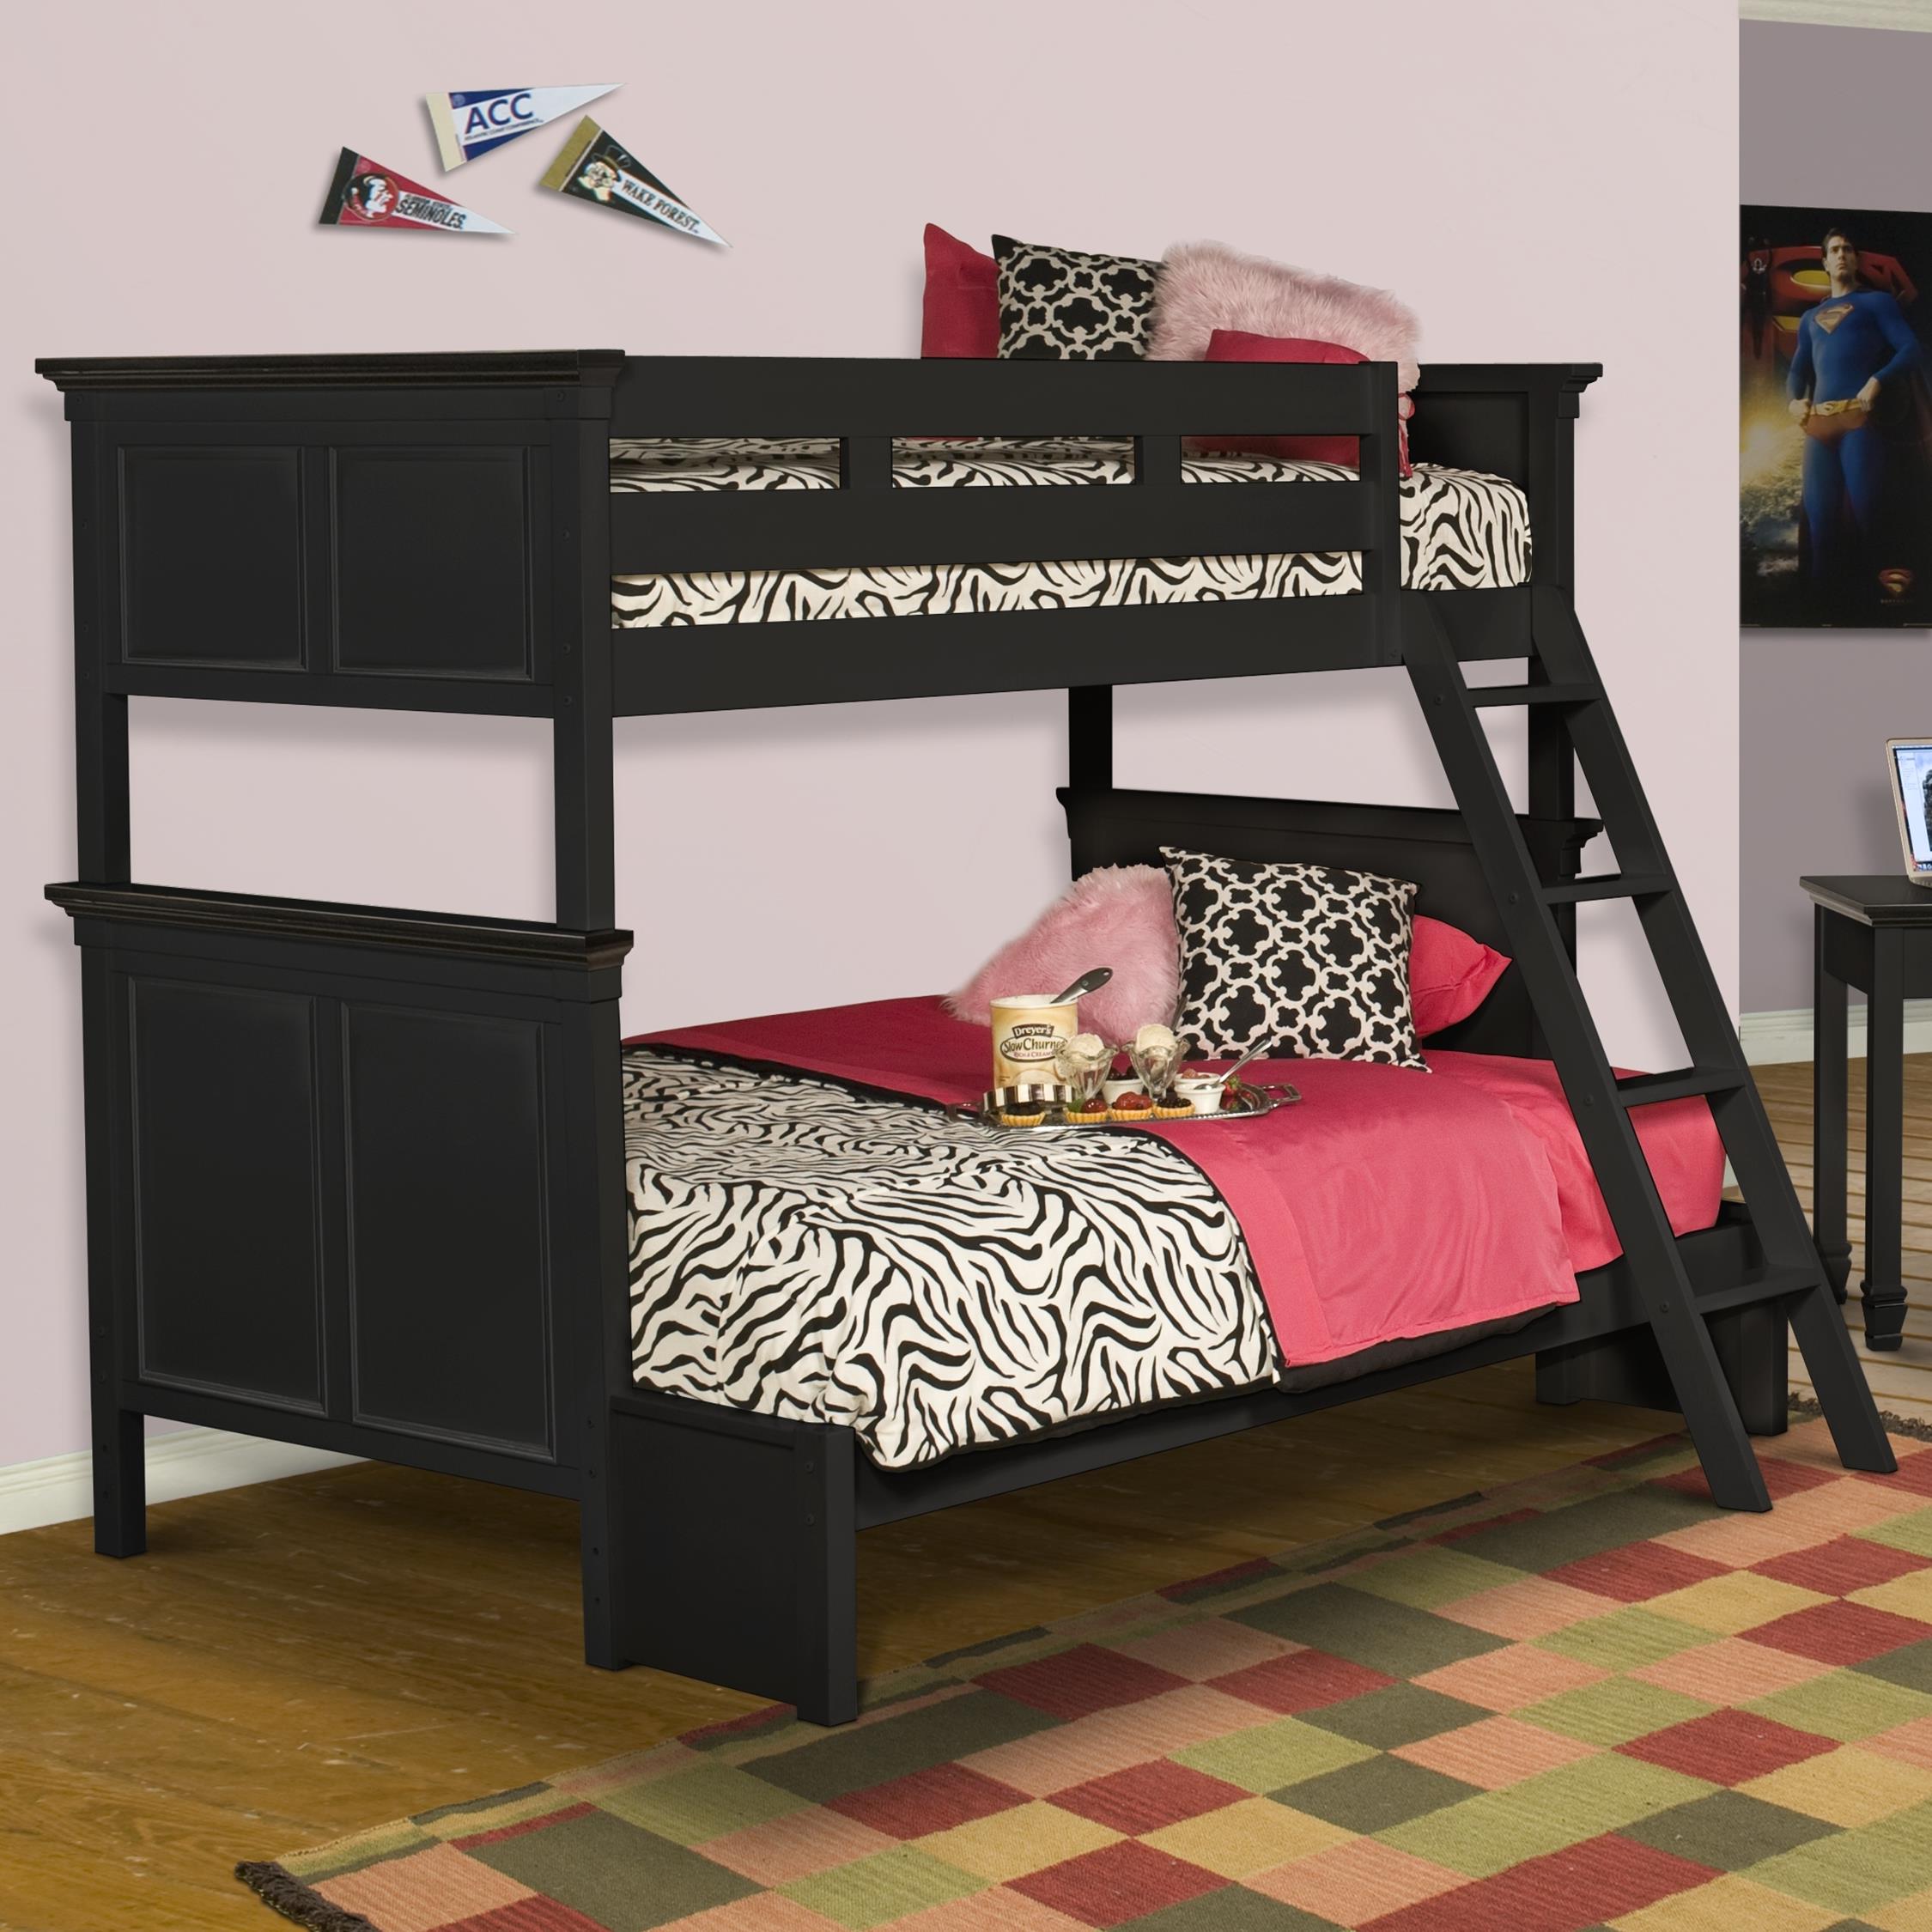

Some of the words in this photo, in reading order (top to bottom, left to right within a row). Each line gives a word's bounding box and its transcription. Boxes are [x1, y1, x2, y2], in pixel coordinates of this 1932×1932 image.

[465, 93, 533, 135] ACC
[394, 198, 466, 229] SEMINOLES
[621, 179, 656, 207] WAKE
[653, 198, 700, 232] FOREST
[1014, 1024, 1052, 1036] Dreyer's
[1004, 1041, 1023, 1053] Slow
